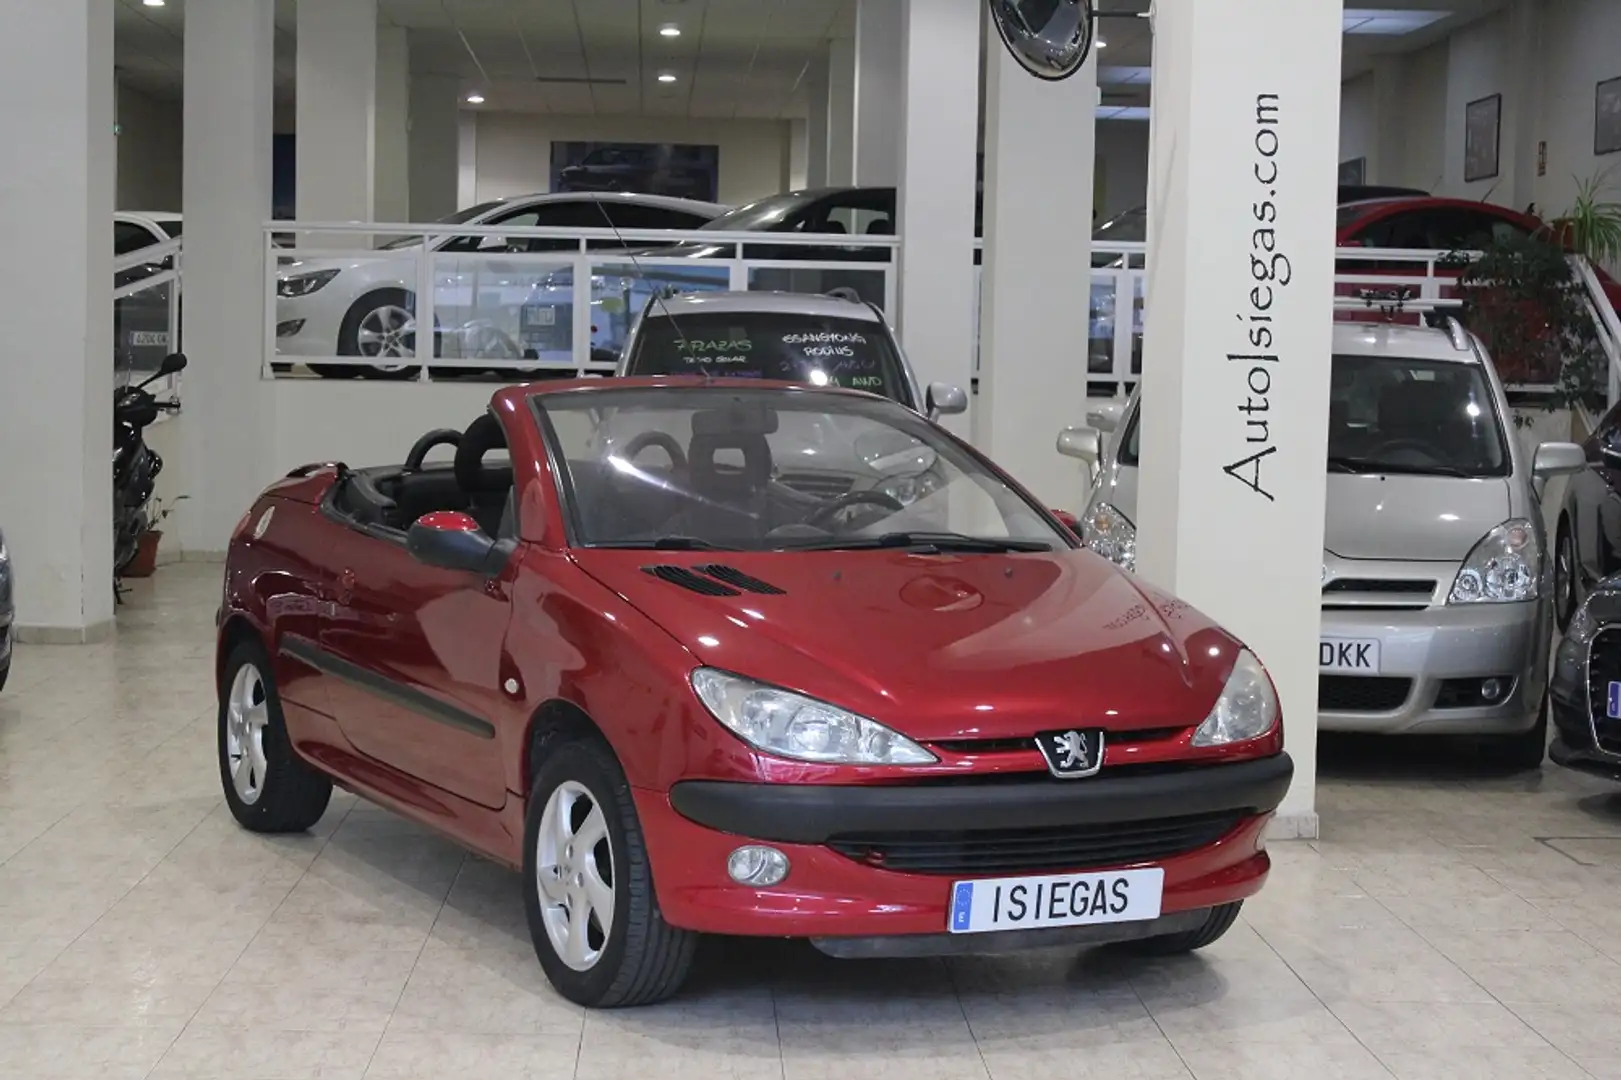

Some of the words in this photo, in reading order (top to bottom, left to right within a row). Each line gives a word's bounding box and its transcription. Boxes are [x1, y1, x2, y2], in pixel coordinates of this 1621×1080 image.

[1222, 92, 1292, 502] AutoIsiegas.com
[1319, 642, 1371, 668] DKK
[992, 878, 1129, 923] ISIEGAS
